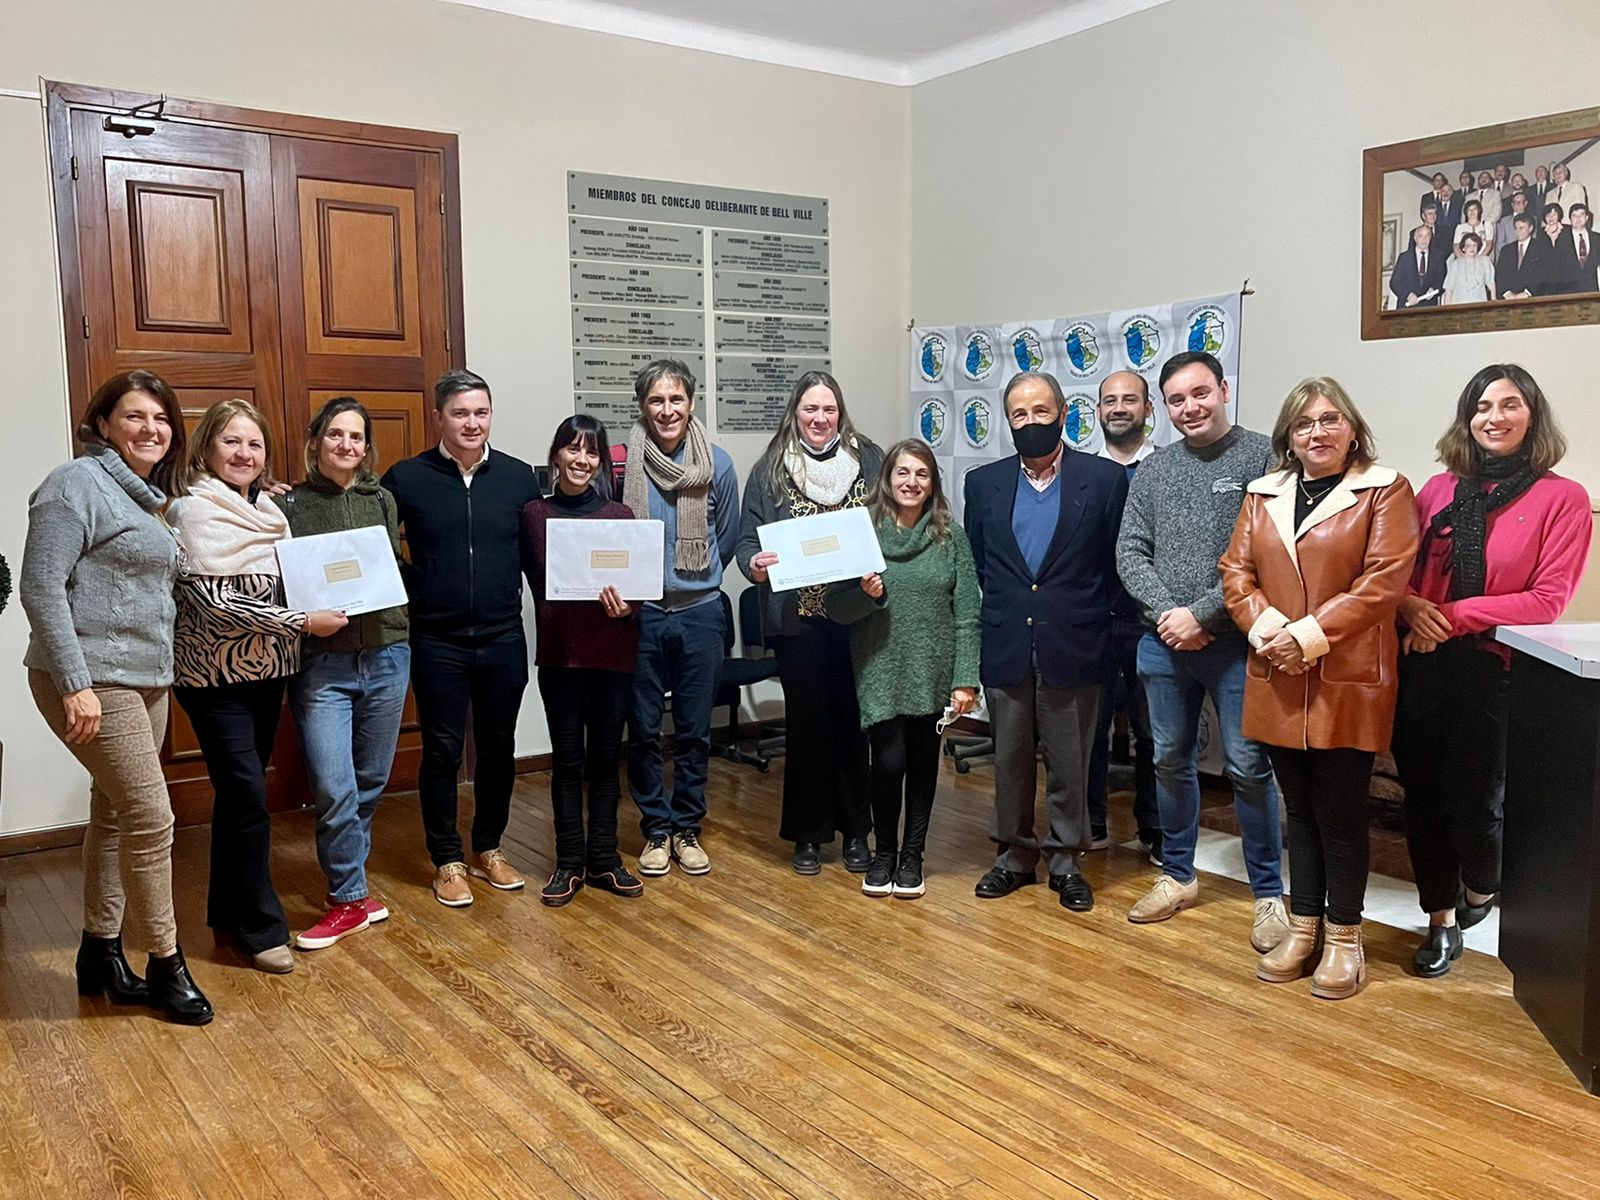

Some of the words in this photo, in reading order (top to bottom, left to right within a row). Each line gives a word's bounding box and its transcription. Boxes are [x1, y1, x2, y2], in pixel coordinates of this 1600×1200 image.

[588, 188, 636, 202] MIEMBROS
[642, 193, 657, 205] DEL
[662, 196, 700, 209] CONCEJO
[705, 200, 757, 215] DELIBERANTE
[760, 206, 770, 216] DE
[772, 207, 789, 218] BELL
[793, 209, 813, 220] VILLE
